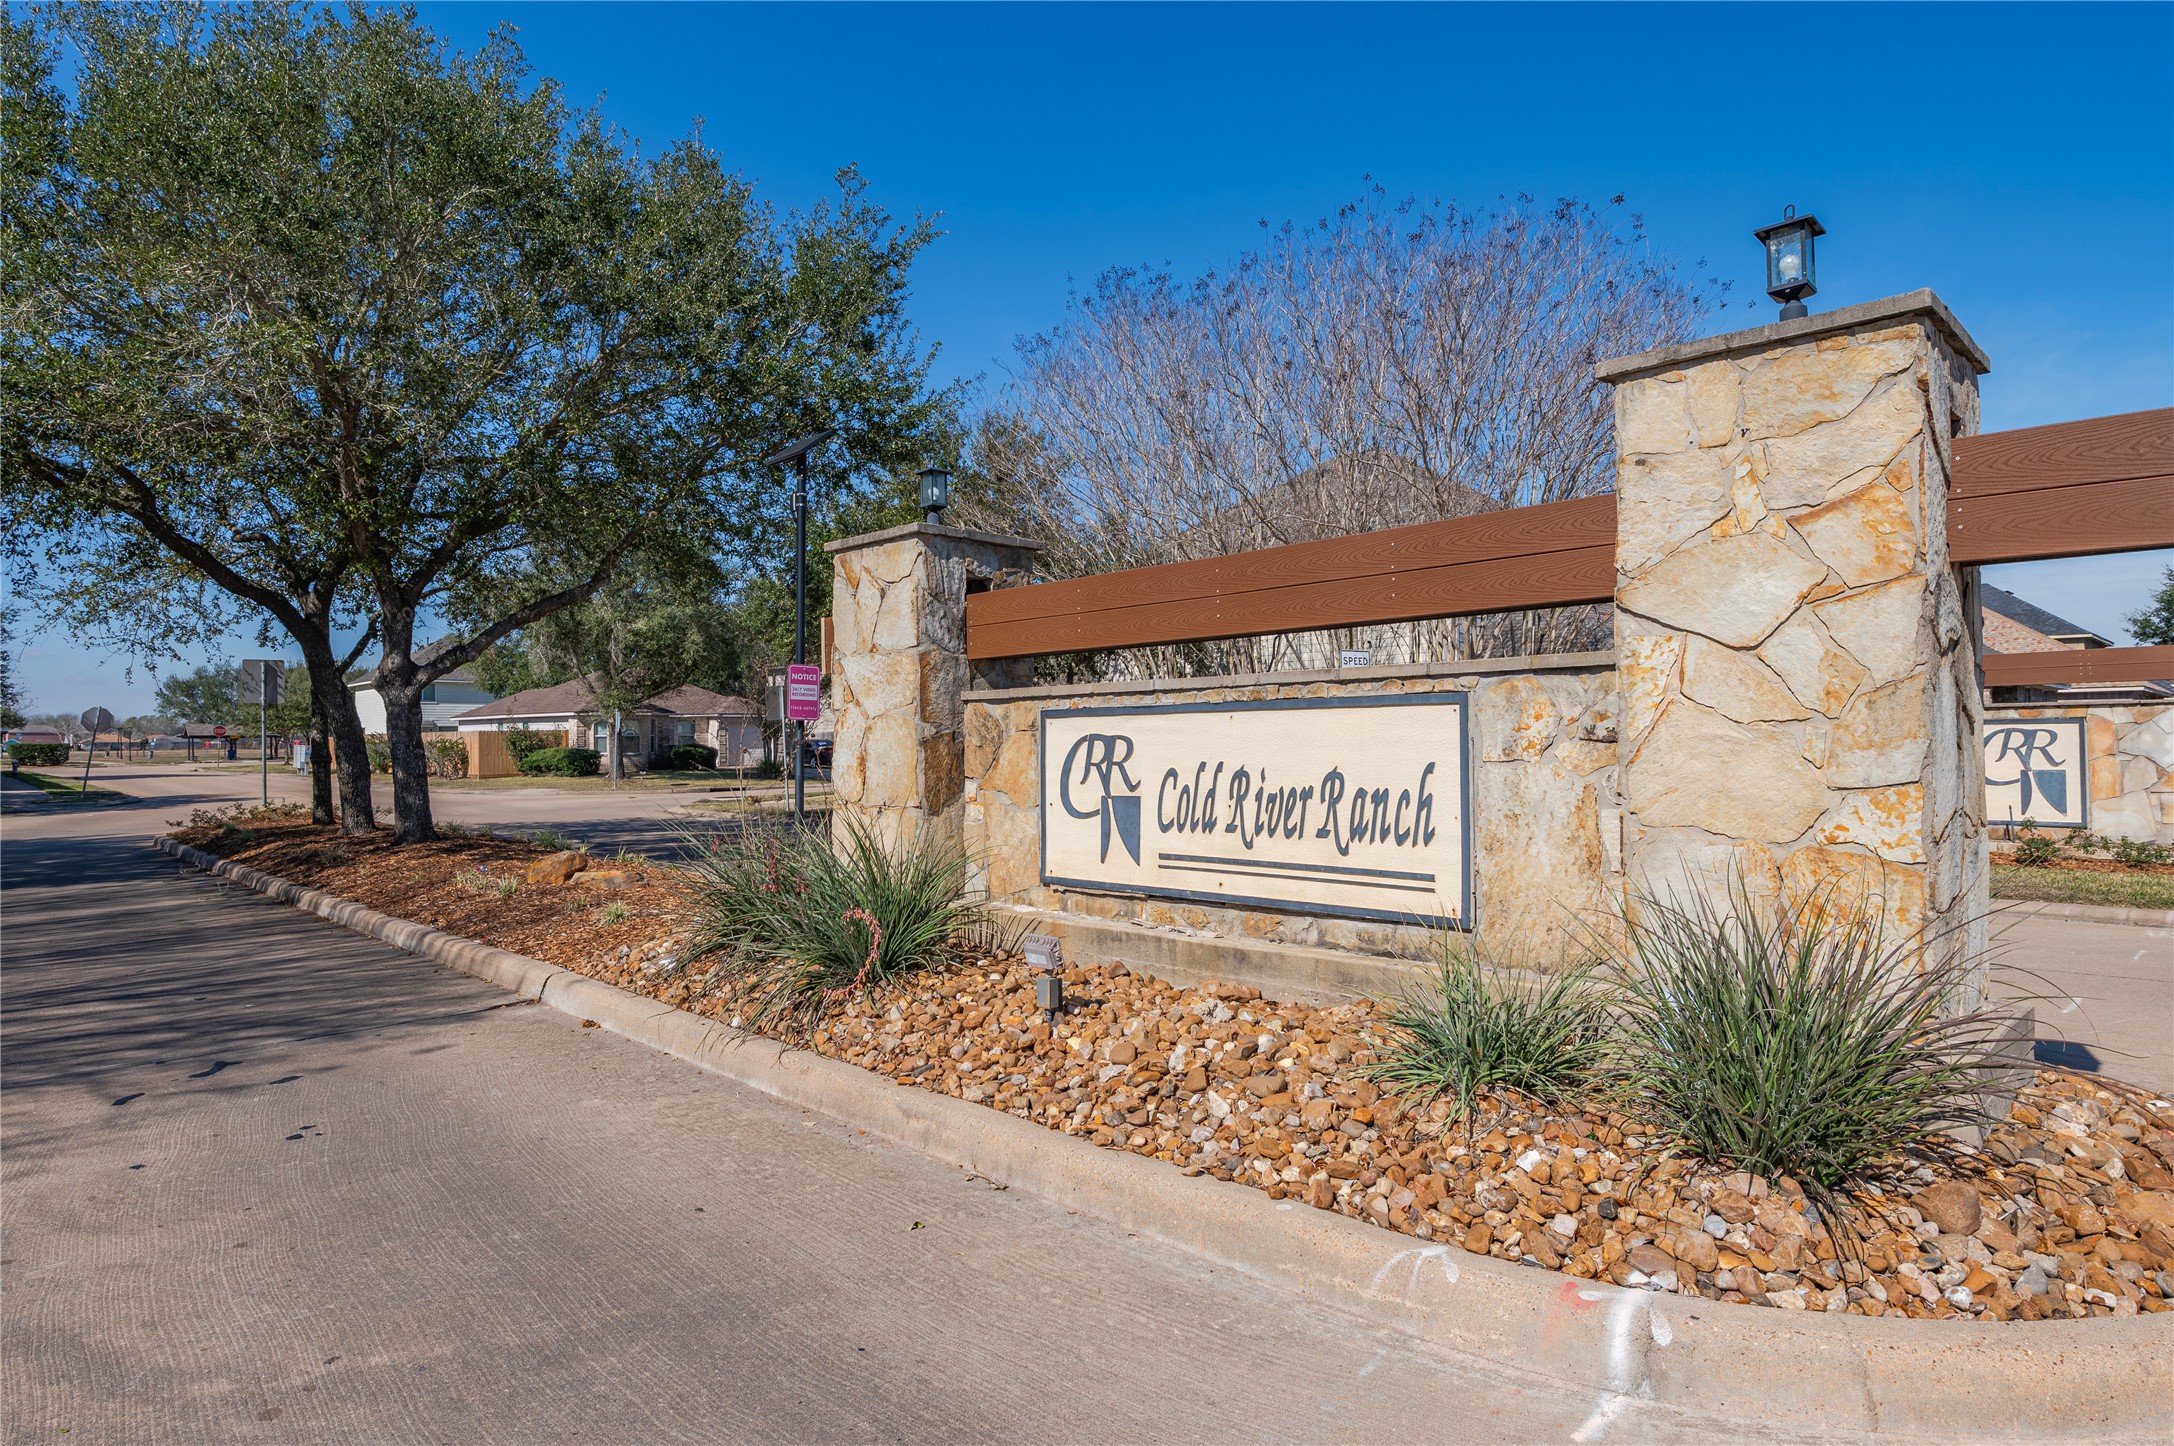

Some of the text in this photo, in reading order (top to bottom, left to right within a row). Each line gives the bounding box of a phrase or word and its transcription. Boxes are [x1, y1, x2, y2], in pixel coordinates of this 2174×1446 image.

[1343, 656, 1368, 666] SPEED
[1157, 761, 1436, 857] Cold River Ranch
